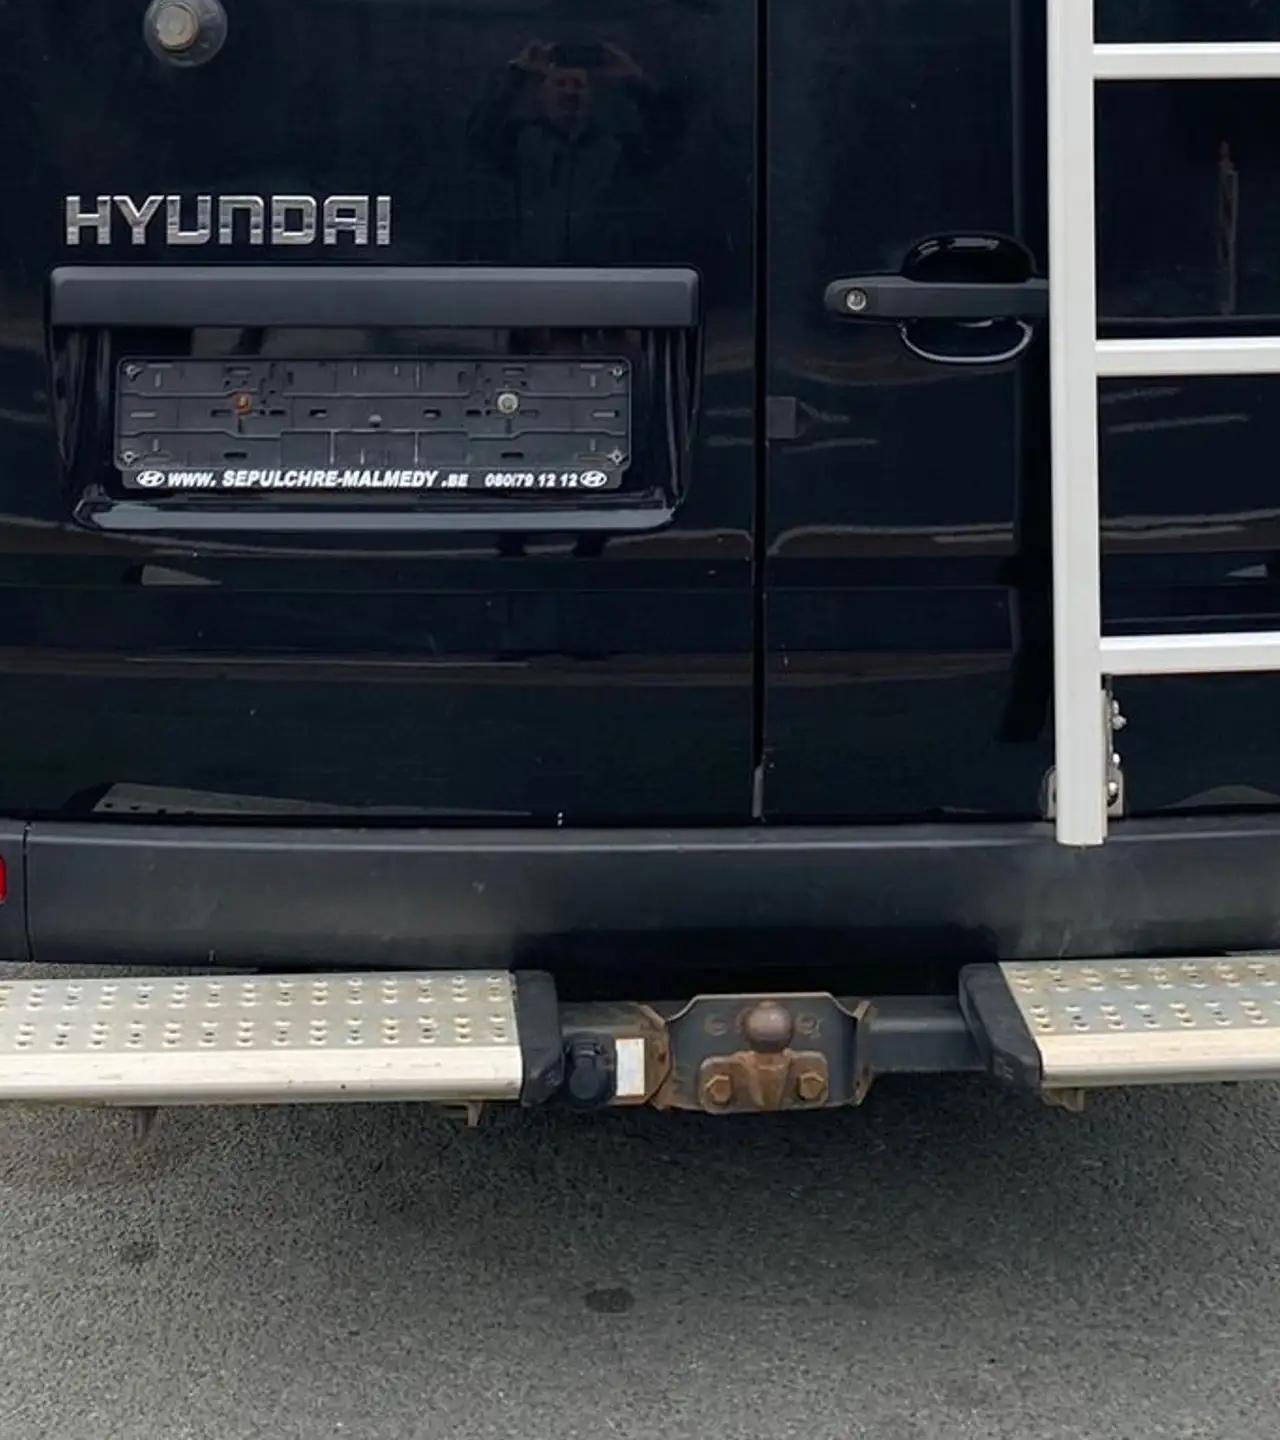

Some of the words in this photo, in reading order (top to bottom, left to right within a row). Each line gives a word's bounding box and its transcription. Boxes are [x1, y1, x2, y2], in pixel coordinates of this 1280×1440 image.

[65, 195, 391, 245] HYUNDAI
[221, 469, 438, 488] SEPULCHRE-MALMEDY
[537, 472, 557, 488] 12
[559, 472, 578, 488] 12
